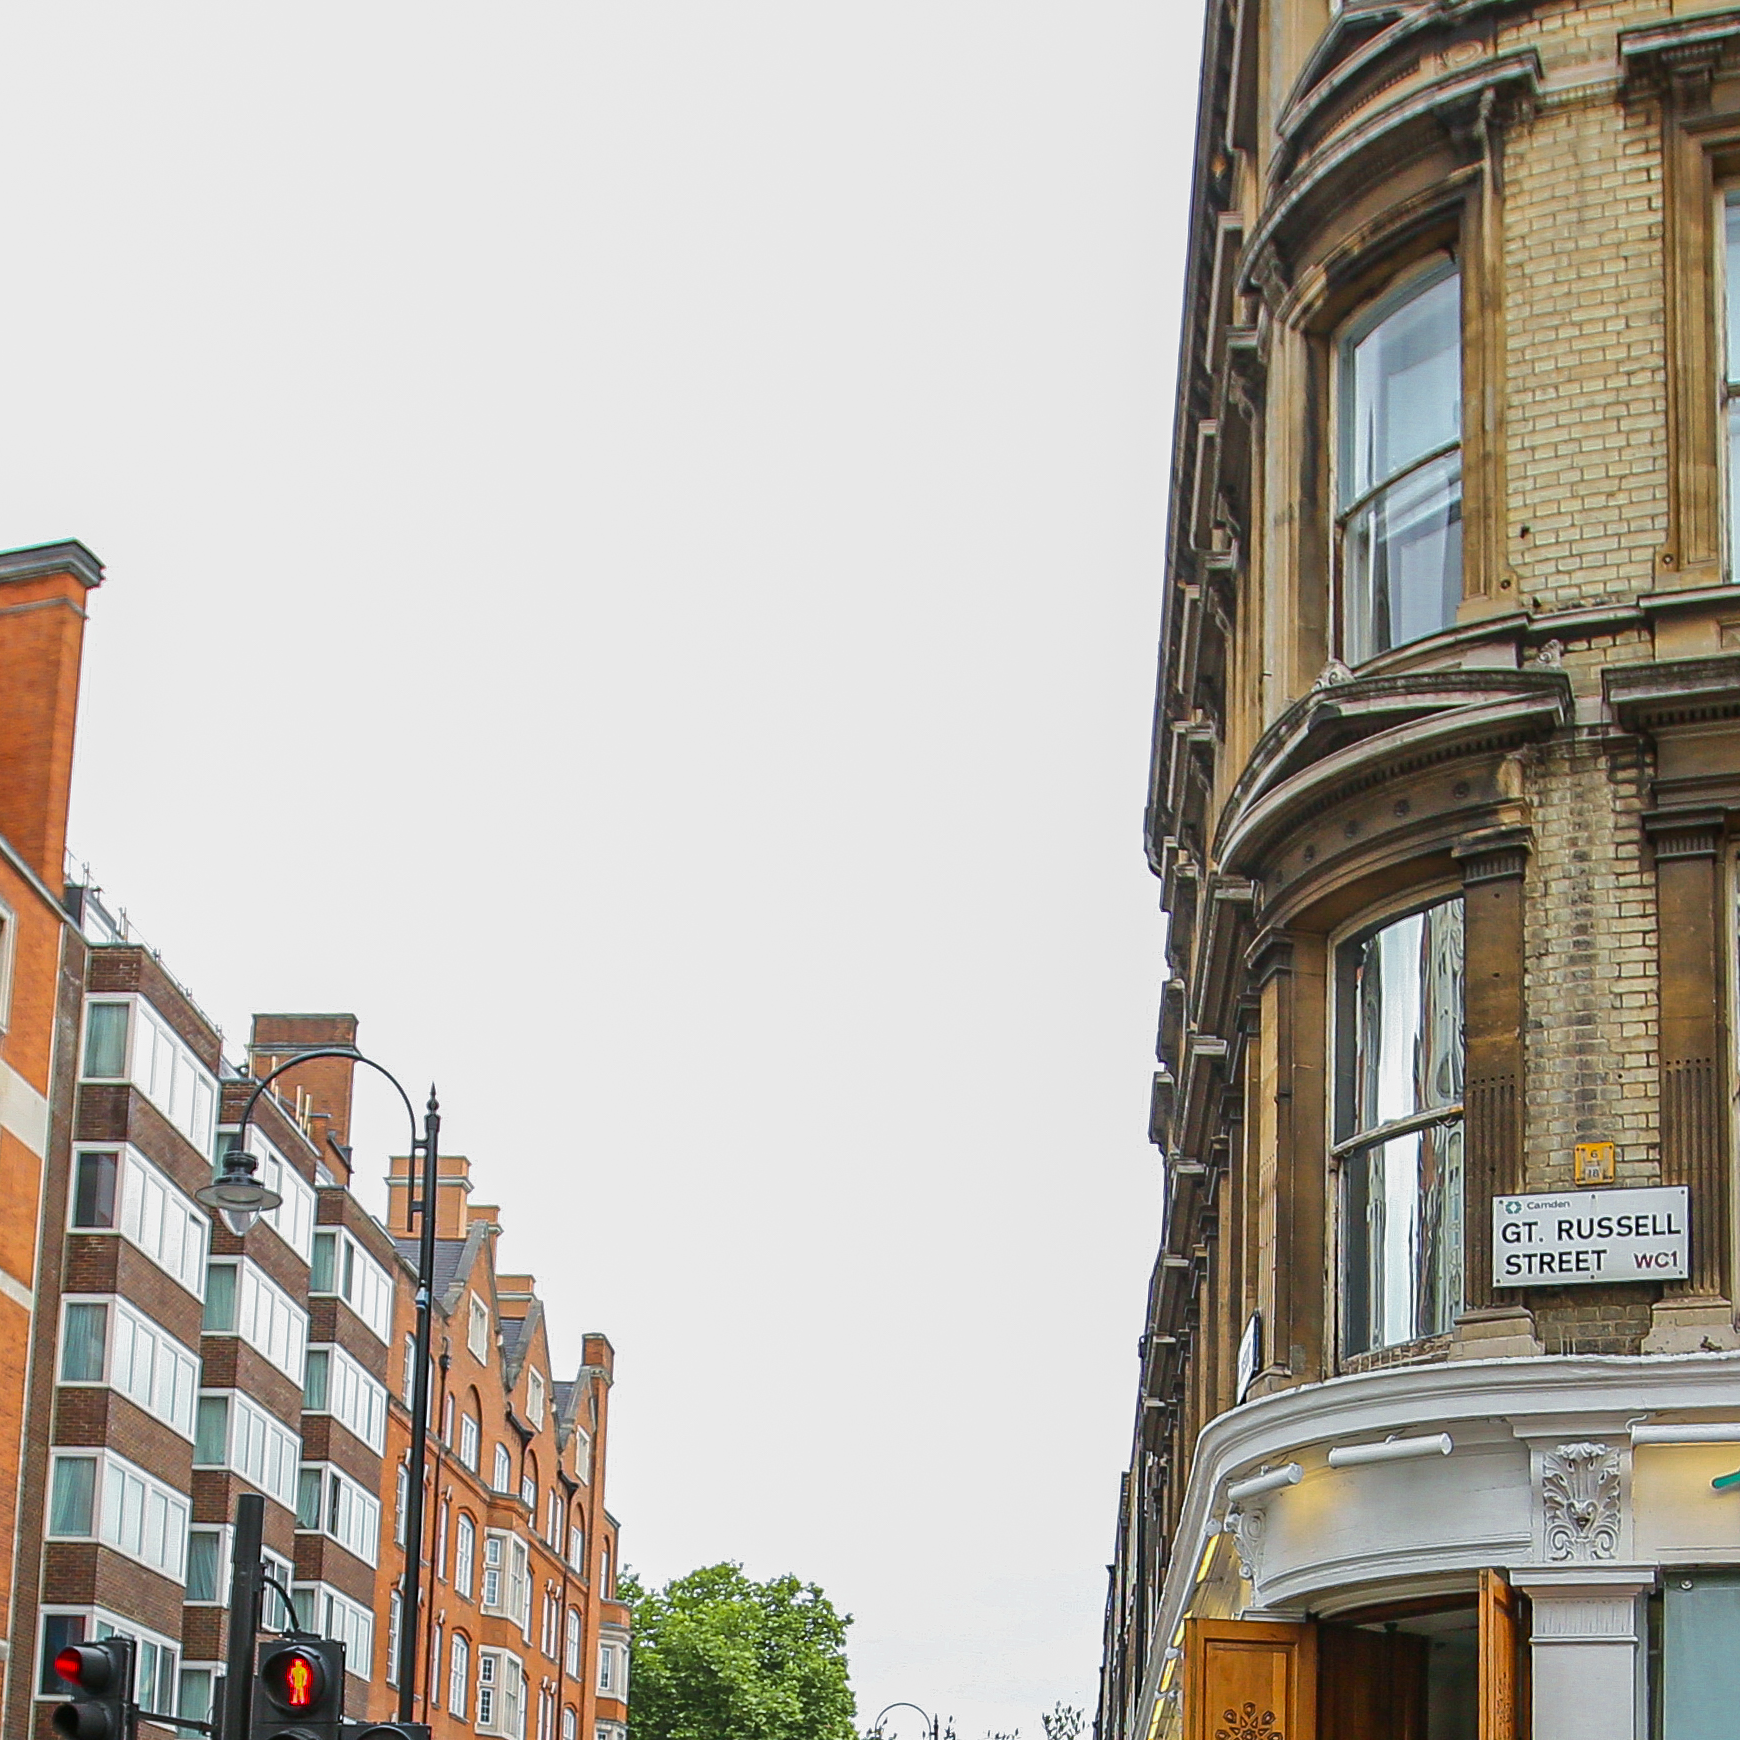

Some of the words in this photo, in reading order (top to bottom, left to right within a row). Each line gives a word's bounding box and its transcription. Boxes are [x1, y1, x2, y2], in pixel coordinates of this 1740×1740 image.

[1526, 1200, 1571, 1210] Camden
[1501, 1220, 1544, 1244] GT.
[1557, 1213, 1681, 1241] RUSSELL
[1505, 1249, 1607, 1275] STREET
[1633, 1250, 1678, 1269] WC1
